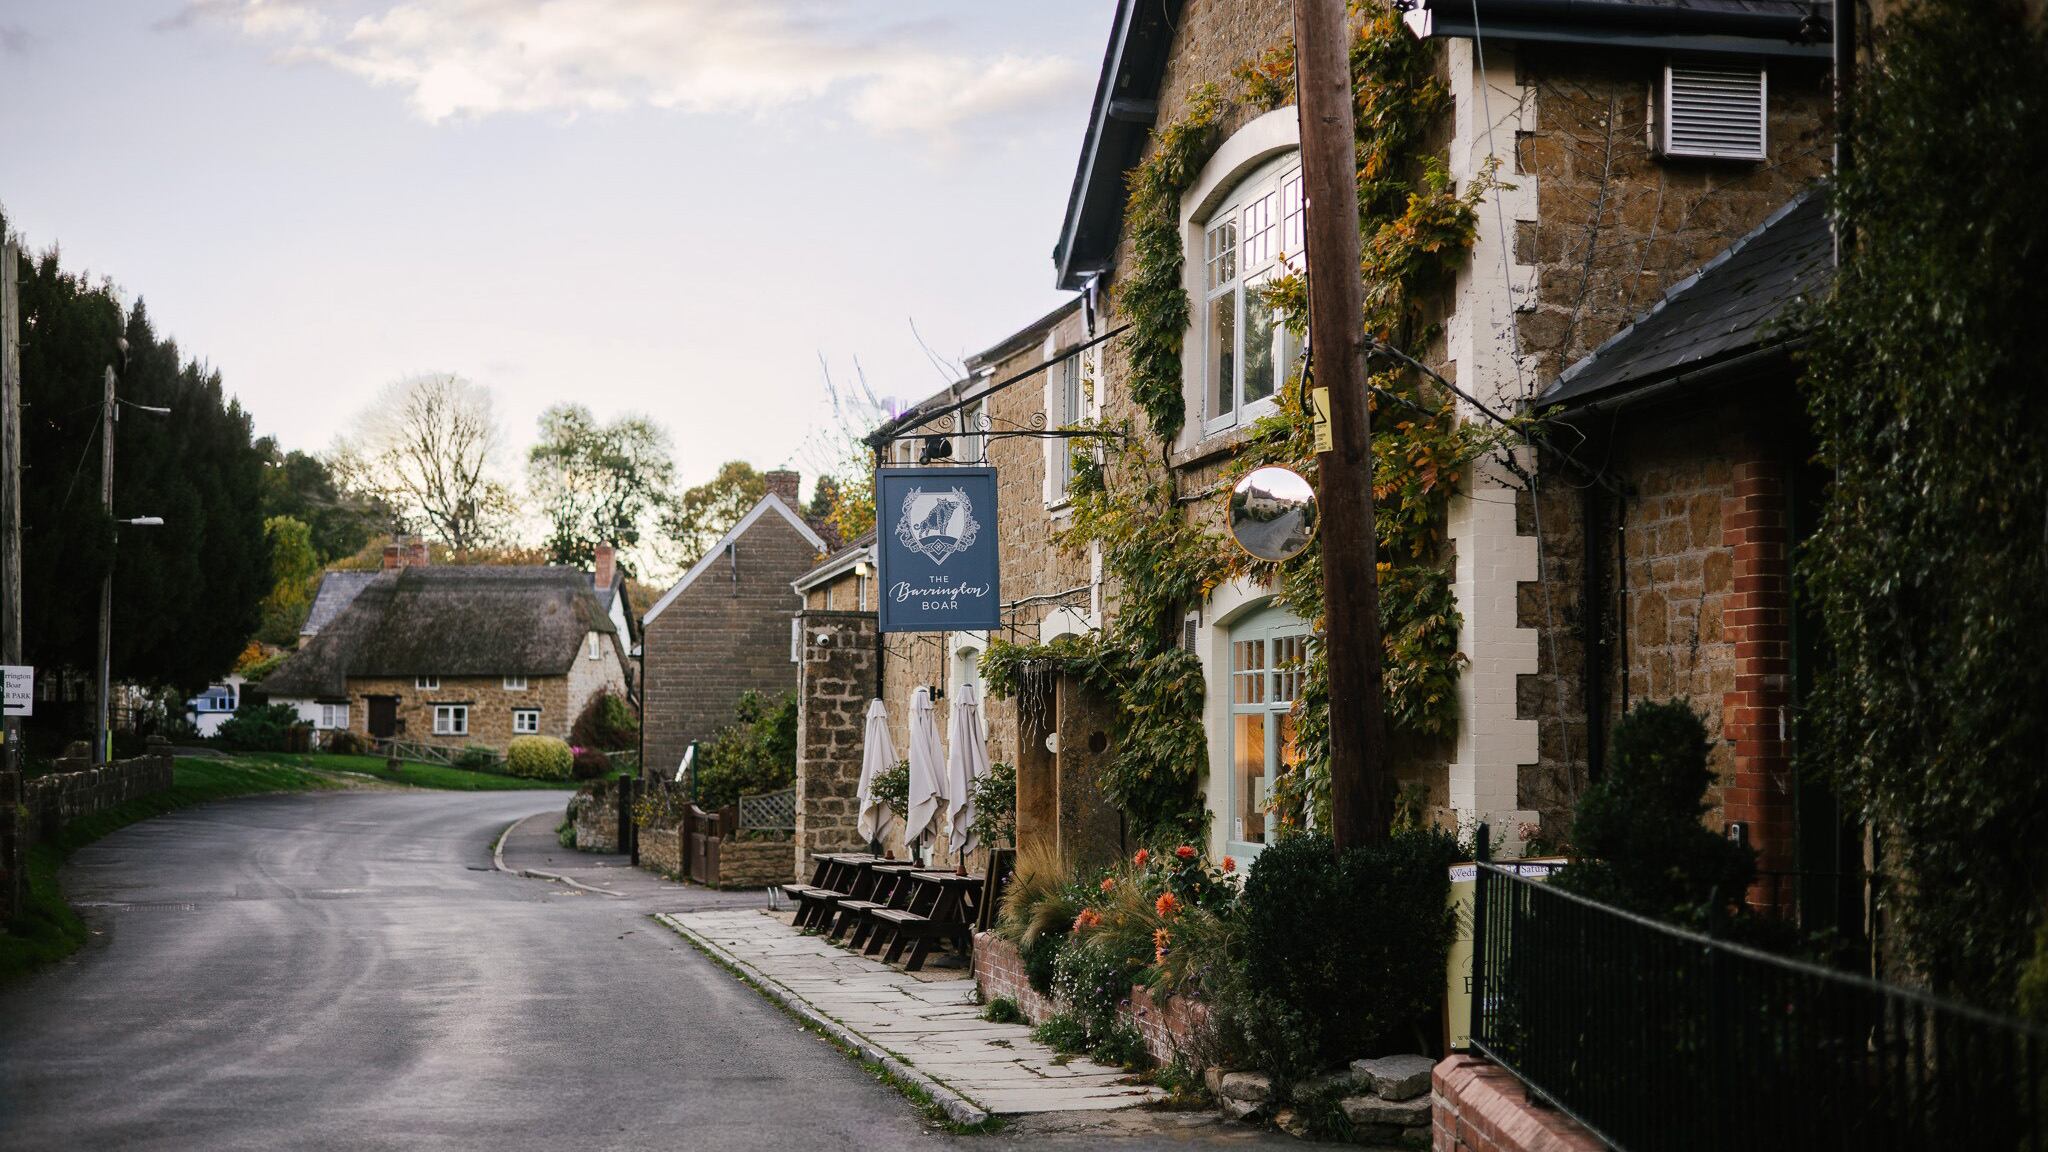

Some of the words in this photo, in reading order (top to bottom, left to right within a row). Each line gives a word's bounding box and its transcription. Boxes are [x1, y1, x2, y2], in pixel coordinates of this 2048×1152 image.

[929, 575, 949, 583] THE
[889, 581, 990, 603] Barrington
[922, 601, 958, 610] BOAR
[4, 672, 32, 680] rrington
